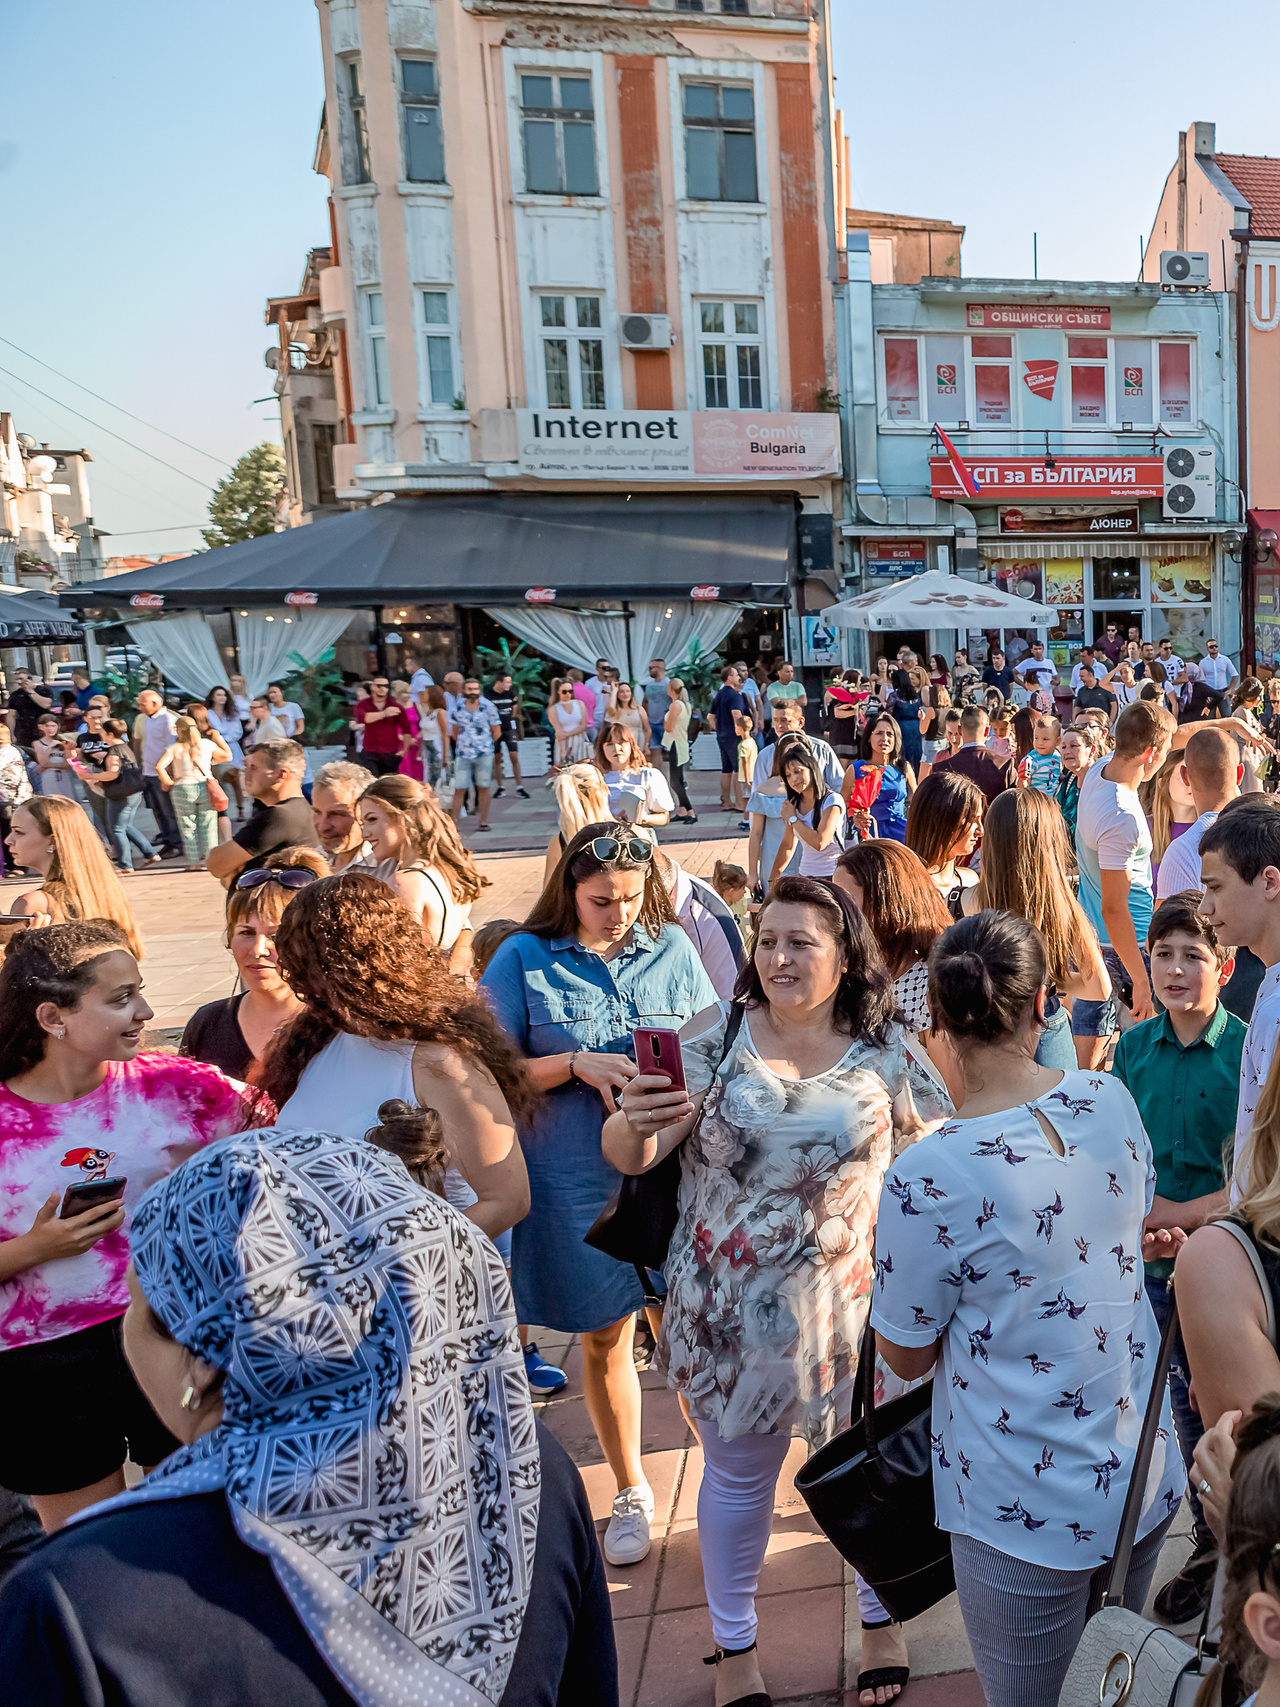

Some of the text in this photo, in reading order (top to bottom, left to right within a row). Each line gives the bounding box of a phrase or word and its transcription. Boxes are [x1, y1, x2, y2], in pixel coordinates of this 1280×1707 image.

[991, 312, 1103, 324] ОБЩИНСКИ СЪВЕТ
[937, 386, 957, 394] БСП
[1124, 388, 1143, 396] БСП
[532, 413, 679, 439] Internet
[745, 424, 815, 440] ComNet
[750, 442, 806, 456] Bulgaria
[967, 467, 1136, 484] СП за БЪЛГАРИЯ
[1089, 518, 1133, 530] ДЮНЕР
[892, 550, 911, 558] БСП
[24, 621, 49, 635] AFFE
